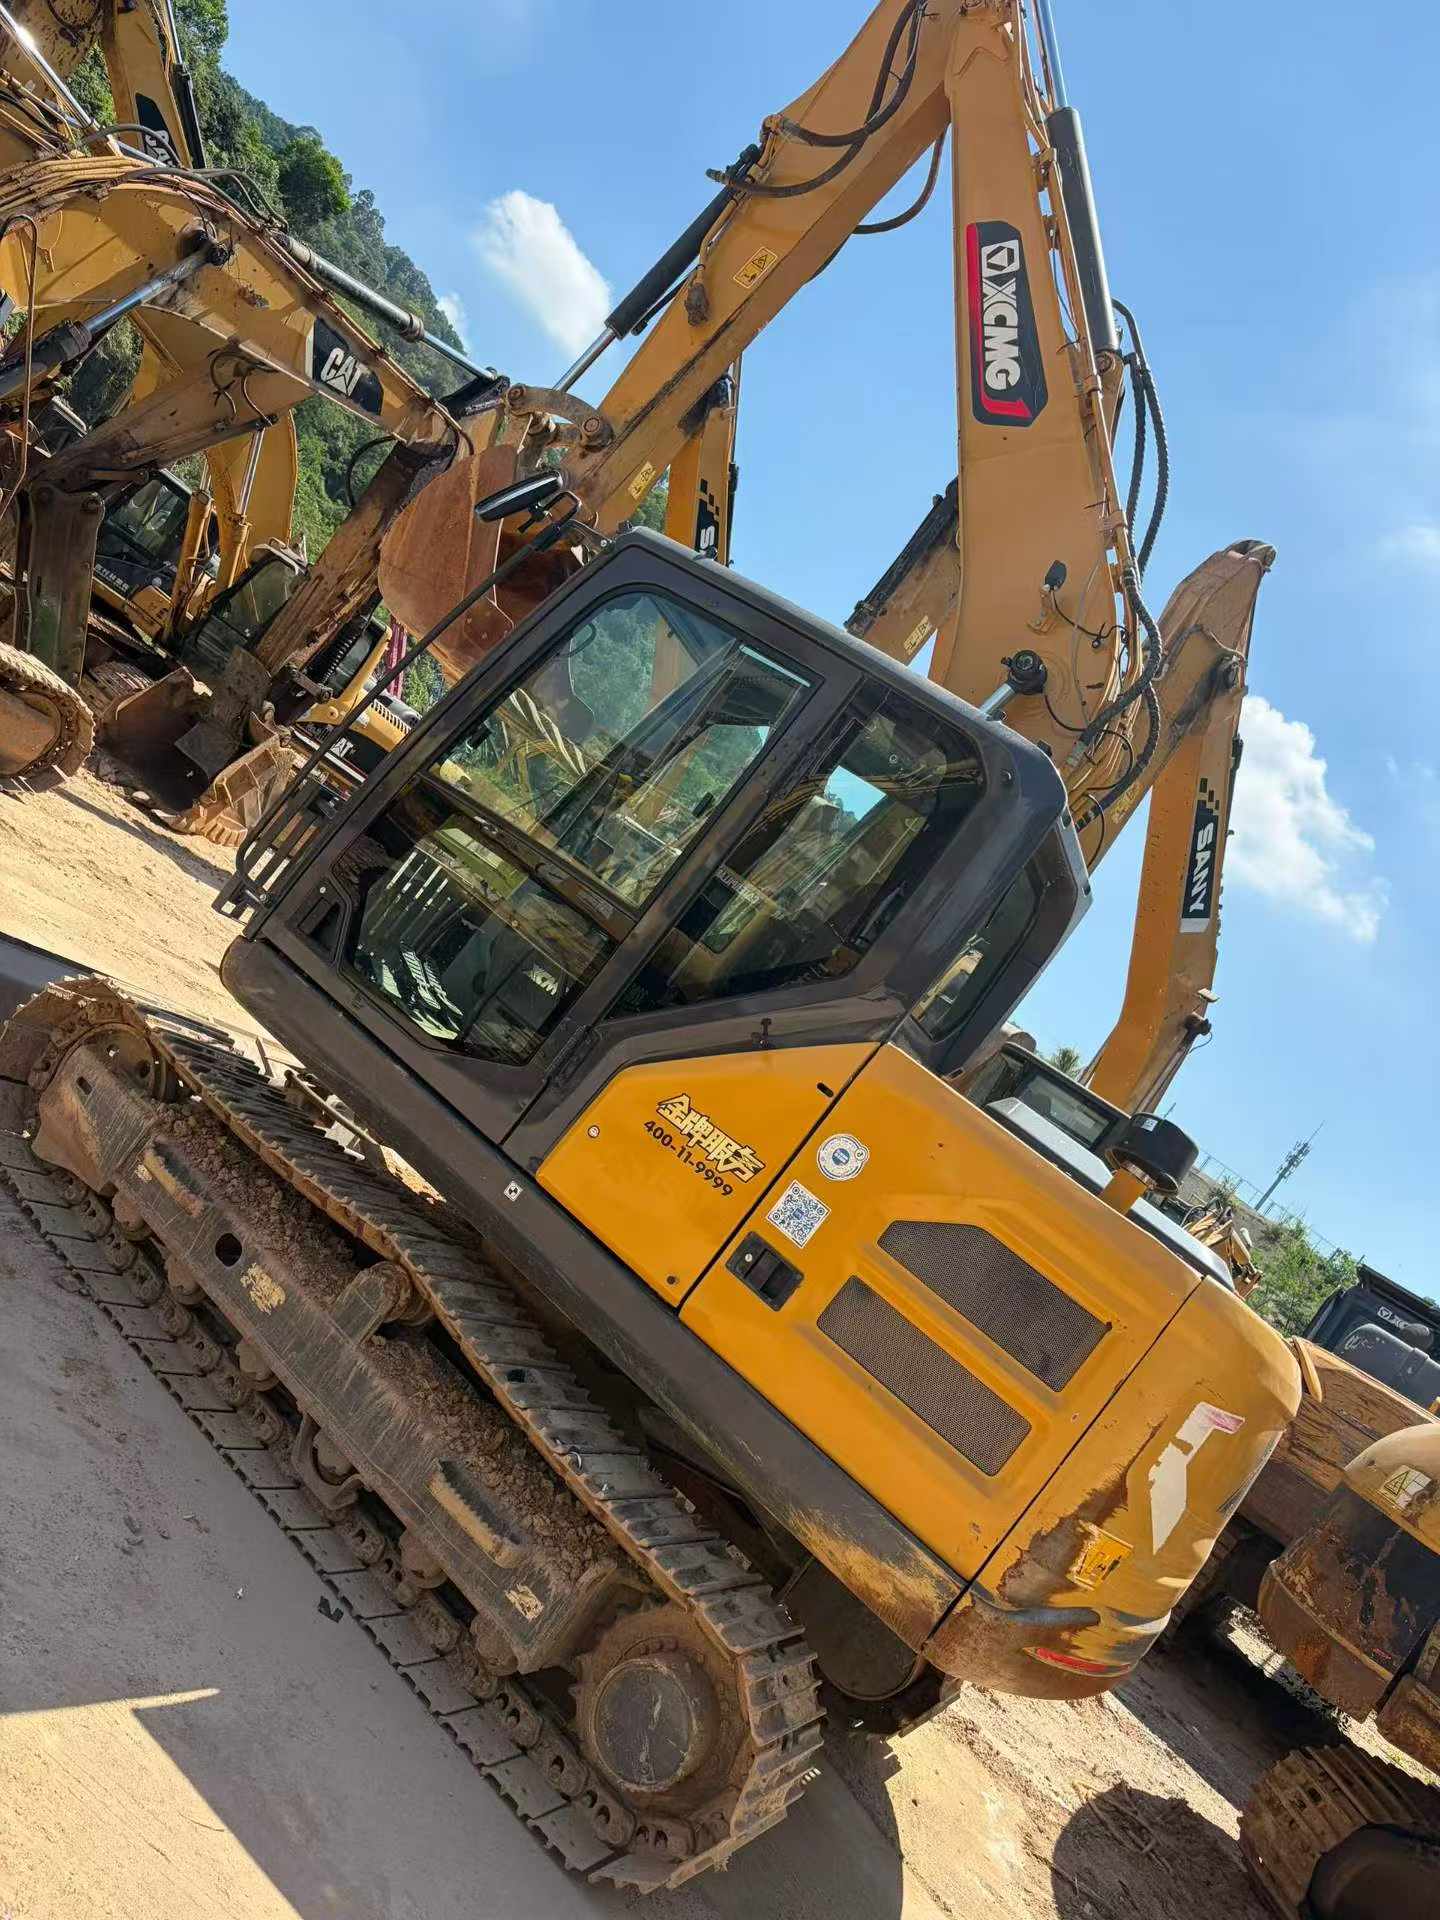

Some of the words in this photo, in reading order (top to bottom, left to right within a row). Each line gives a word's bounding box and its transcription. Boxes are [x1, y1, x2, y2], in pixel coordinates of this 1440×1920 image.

[320, 348, 368, 396] CAT
[983, 277, 1021, 390] XCMG
[1189, 822, 1214, 913] SANY
[643, 1120, 734, 1196] 400-11-9999
